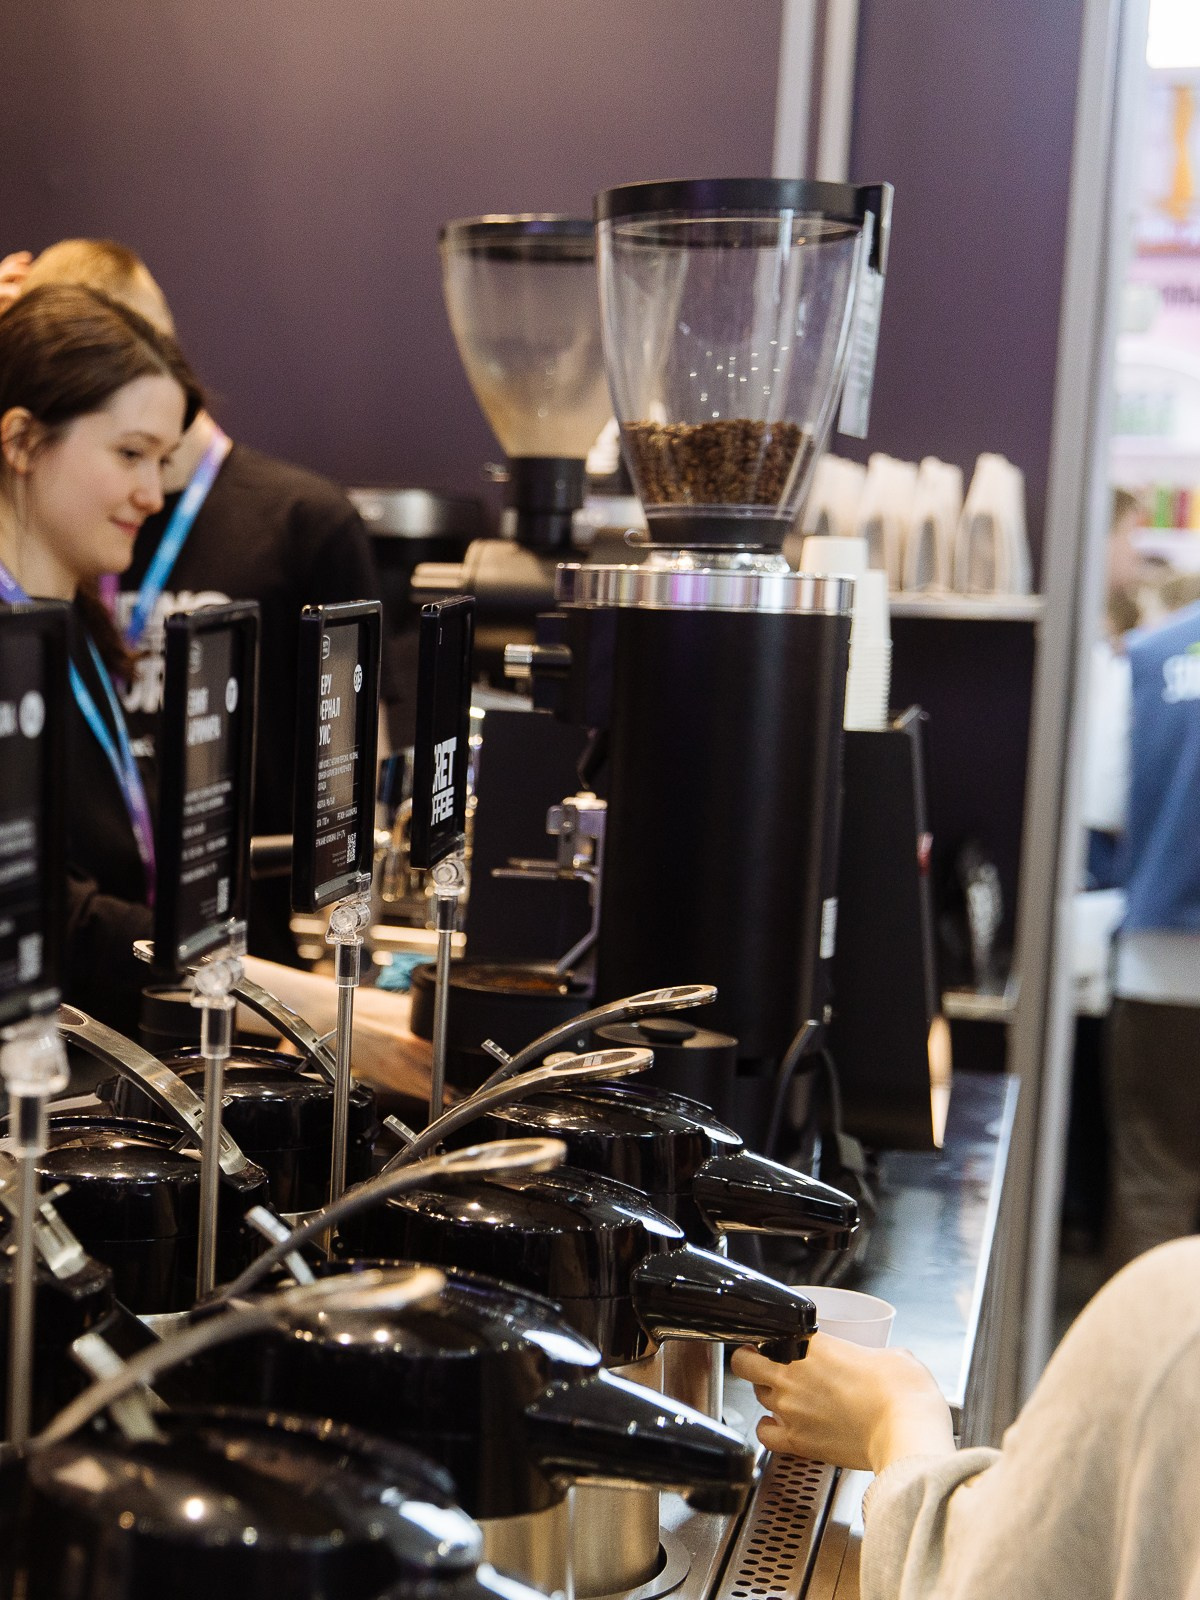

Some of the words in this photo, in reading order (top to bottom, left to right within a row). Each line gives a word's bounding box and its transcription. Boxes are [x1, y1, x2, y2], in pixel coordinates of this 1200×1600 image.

[320, 673, 332, 696] ЕРУ
[319, 697, 341, 721] ЕРНАЛ
[319, 723, 331, 746] УИС
[432, 736, 457, 794] RET
[431, 786, 455, 827] FFEE
